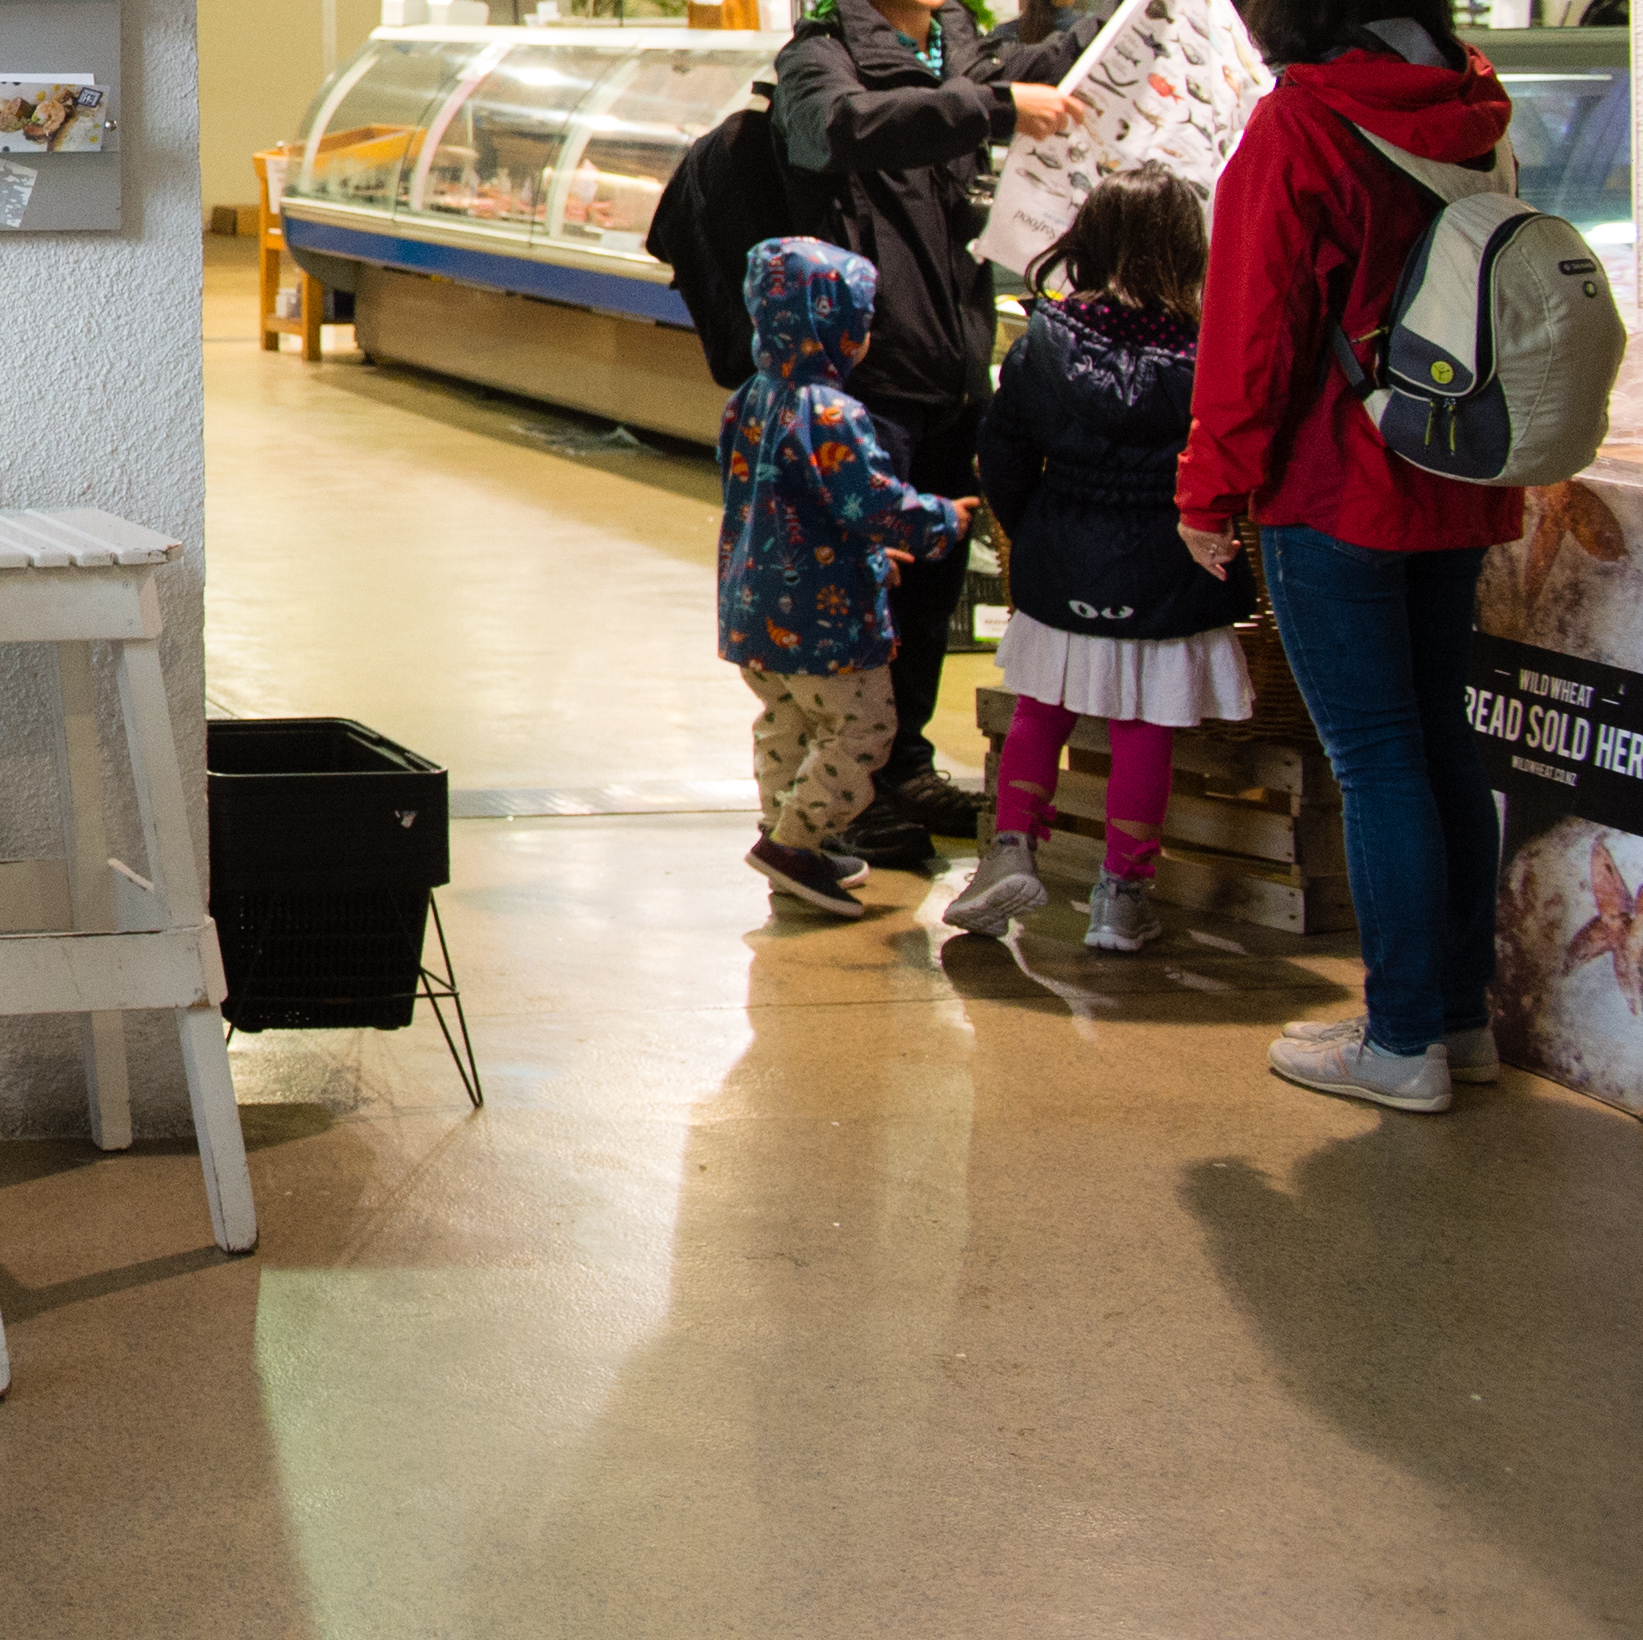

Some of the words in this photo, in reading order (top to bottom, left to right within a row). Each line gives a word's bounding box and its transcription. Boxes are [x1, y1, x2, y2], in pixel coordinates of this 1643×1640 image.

[1519, 668, 1550, 696] WILD
[1550, 676, 1595, 708] WHEAT
[1526, 705, 1591, 760] SOLD
